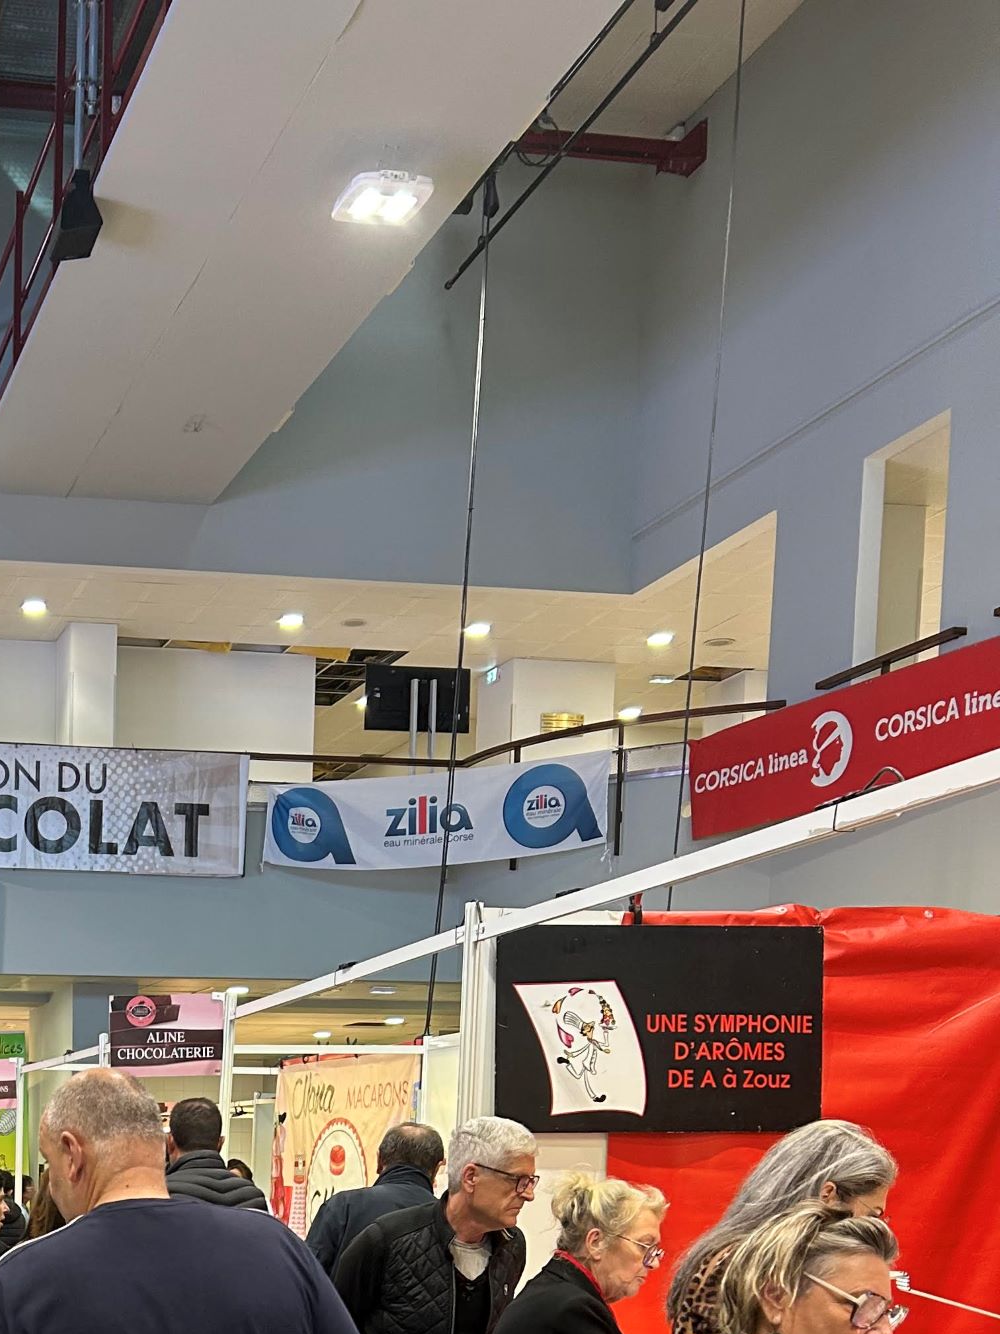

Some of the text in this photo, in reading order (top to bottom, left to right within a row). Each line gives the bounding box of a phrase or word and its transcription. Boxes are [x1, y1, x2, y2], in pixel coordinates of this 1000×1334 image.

[875, 697, 960, 741] CORSICA
[57, 761, 108, 794] DU
[694, 748, 808, 793] CORSICA linea
[527, 794, 561, 811] zilia
[384, 795, 474, 837] zilia
[383, 838, 402, 848] eau
[403, 834, 443, 846] minérale
[646, 1013, 813, 1034] UNE SYMPHONIE
[146, 1031, 186, 1044] ALINE
[117, 1046, 215, 1060] CHOCOLATERIE
[667, 1067, 791, 1089] DE A à Zouz
[346, 1080, 409, 1109] MACARONS
